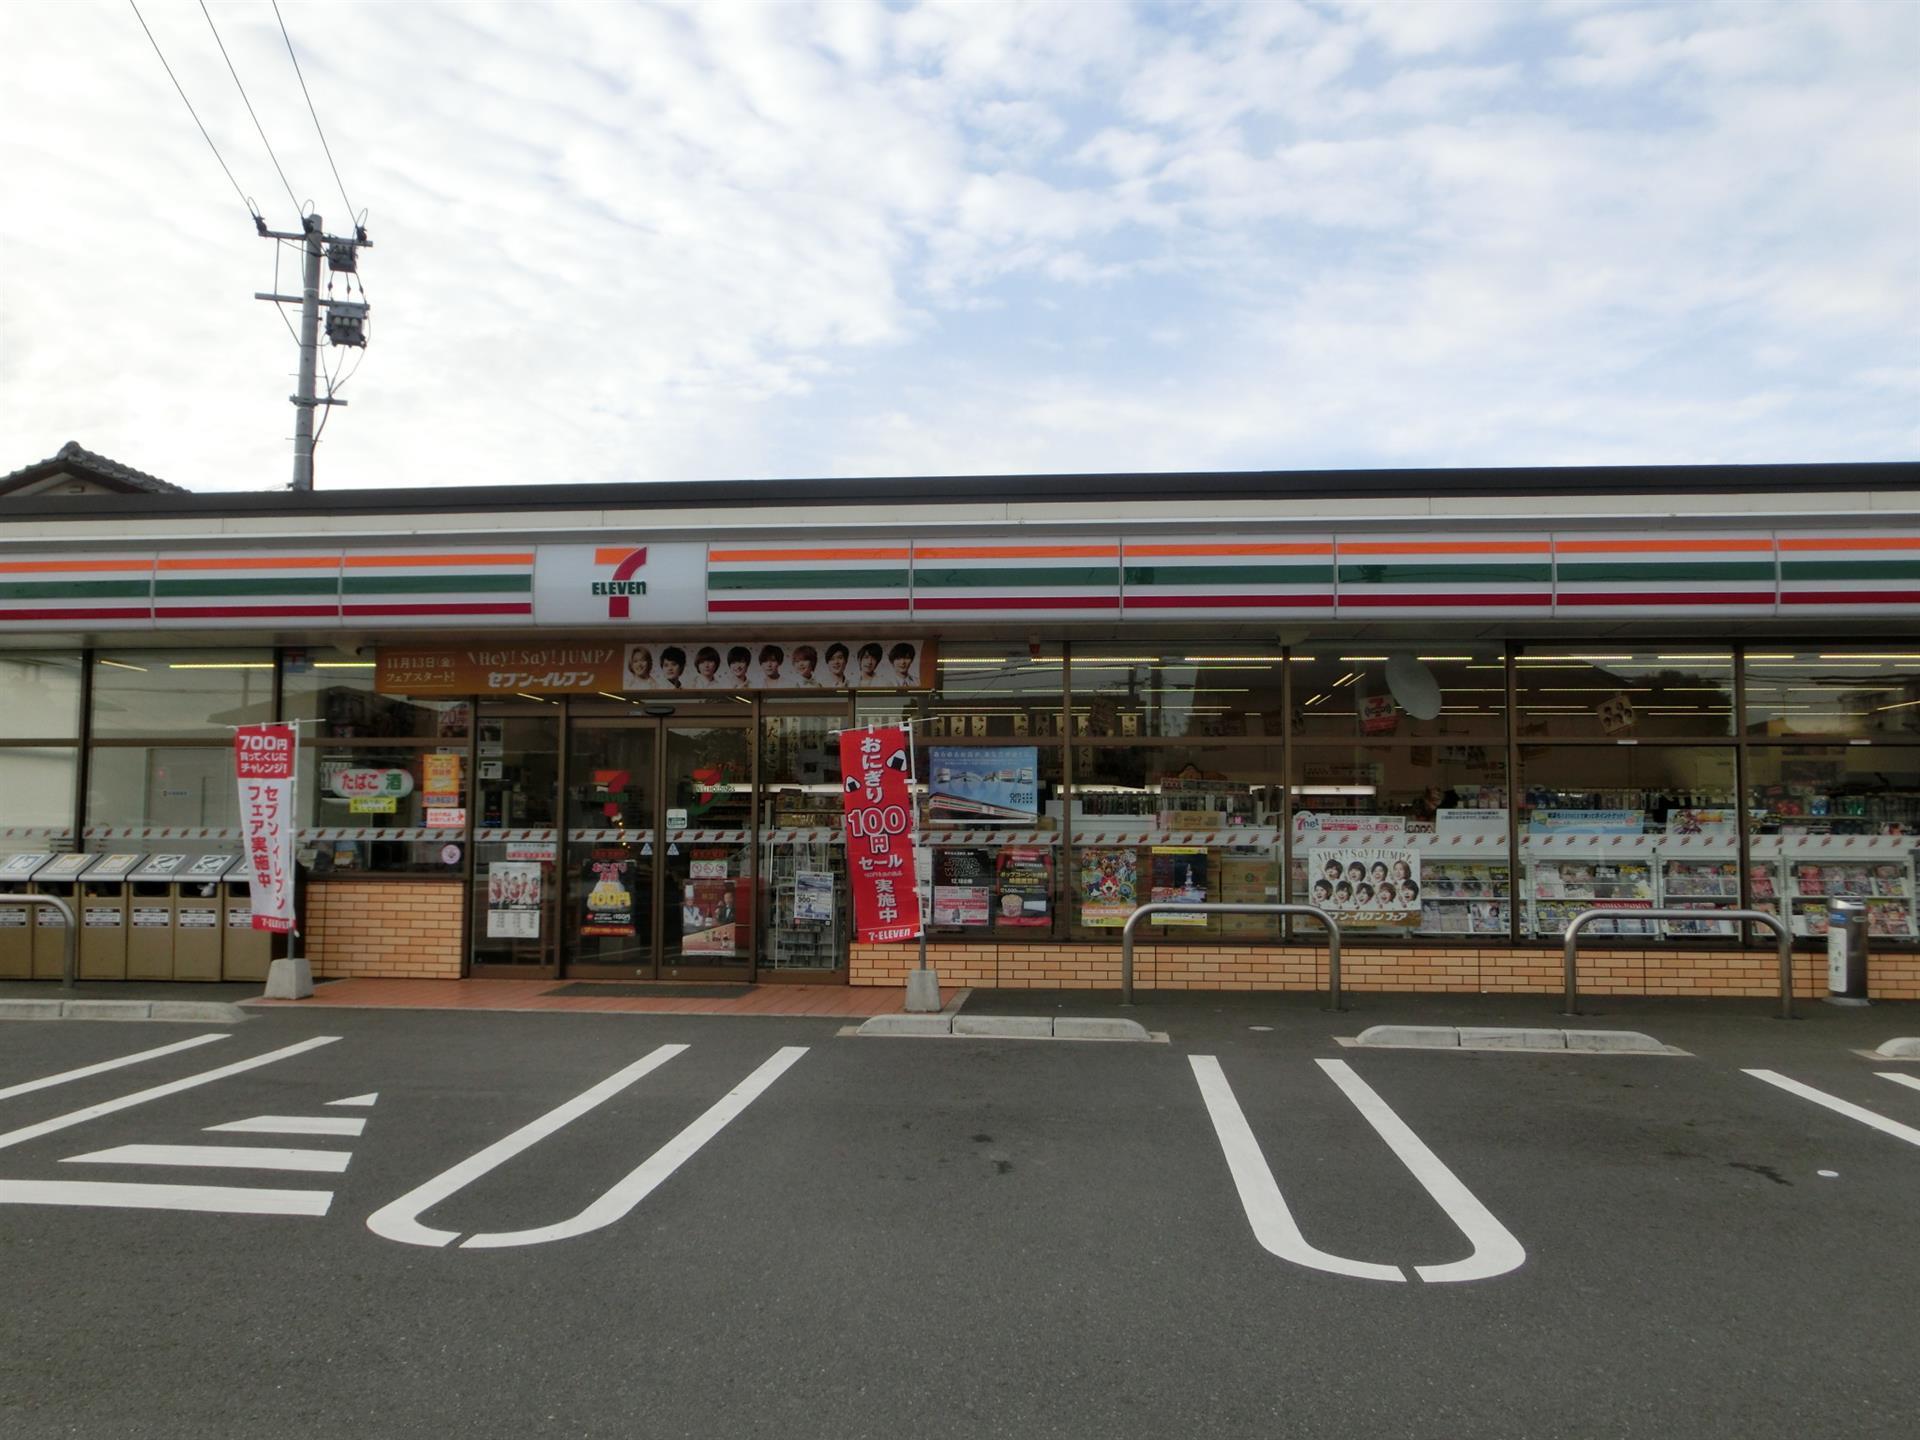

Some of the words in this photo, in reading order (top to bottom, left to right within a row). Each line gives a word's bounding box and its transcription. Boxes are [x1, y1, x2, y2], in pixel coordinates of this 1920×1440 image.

[559, 649, 606, 665] JUMP
[238, 735, 288, 751] 700円
[860, 737, 885, 804] おにぎり
[342, 774, 379, 790] たばこ
[385, 773, 403, 791] 酒
[248, 786, 271, 887] フェア実施中
[858, 854, 903, 871] セール
[875, 879, 899, 923] 実施中
